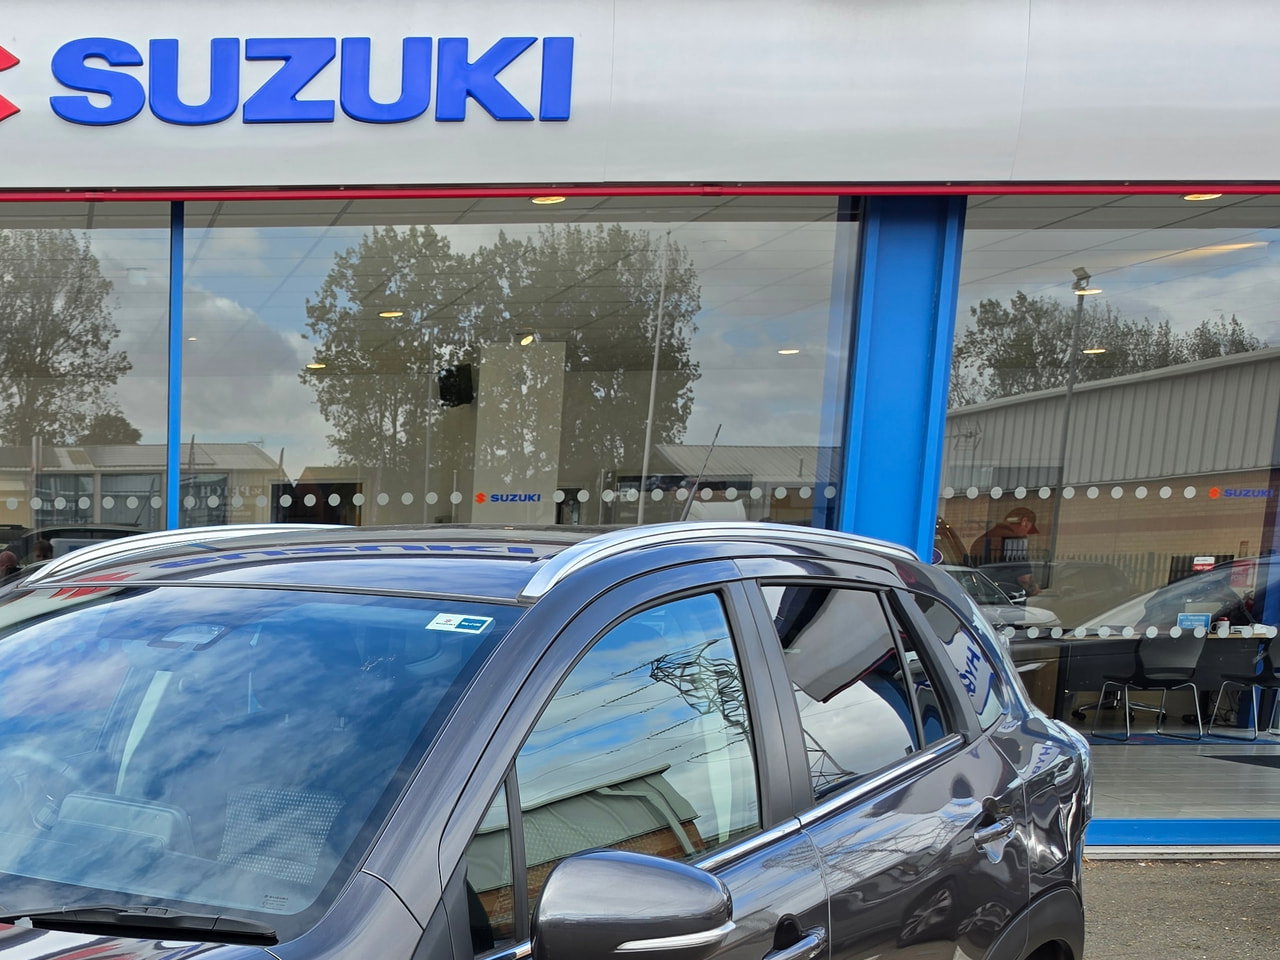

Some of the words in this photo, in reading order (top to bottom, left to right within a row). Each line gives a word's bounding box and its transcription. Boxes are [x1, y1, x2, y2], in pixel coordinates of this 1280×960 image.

[50, 36, 573, 125] SUZUKI
[1224, 488, 1274, 497] SUZUKI
[490, 493, 541, 502] SUZUKI
